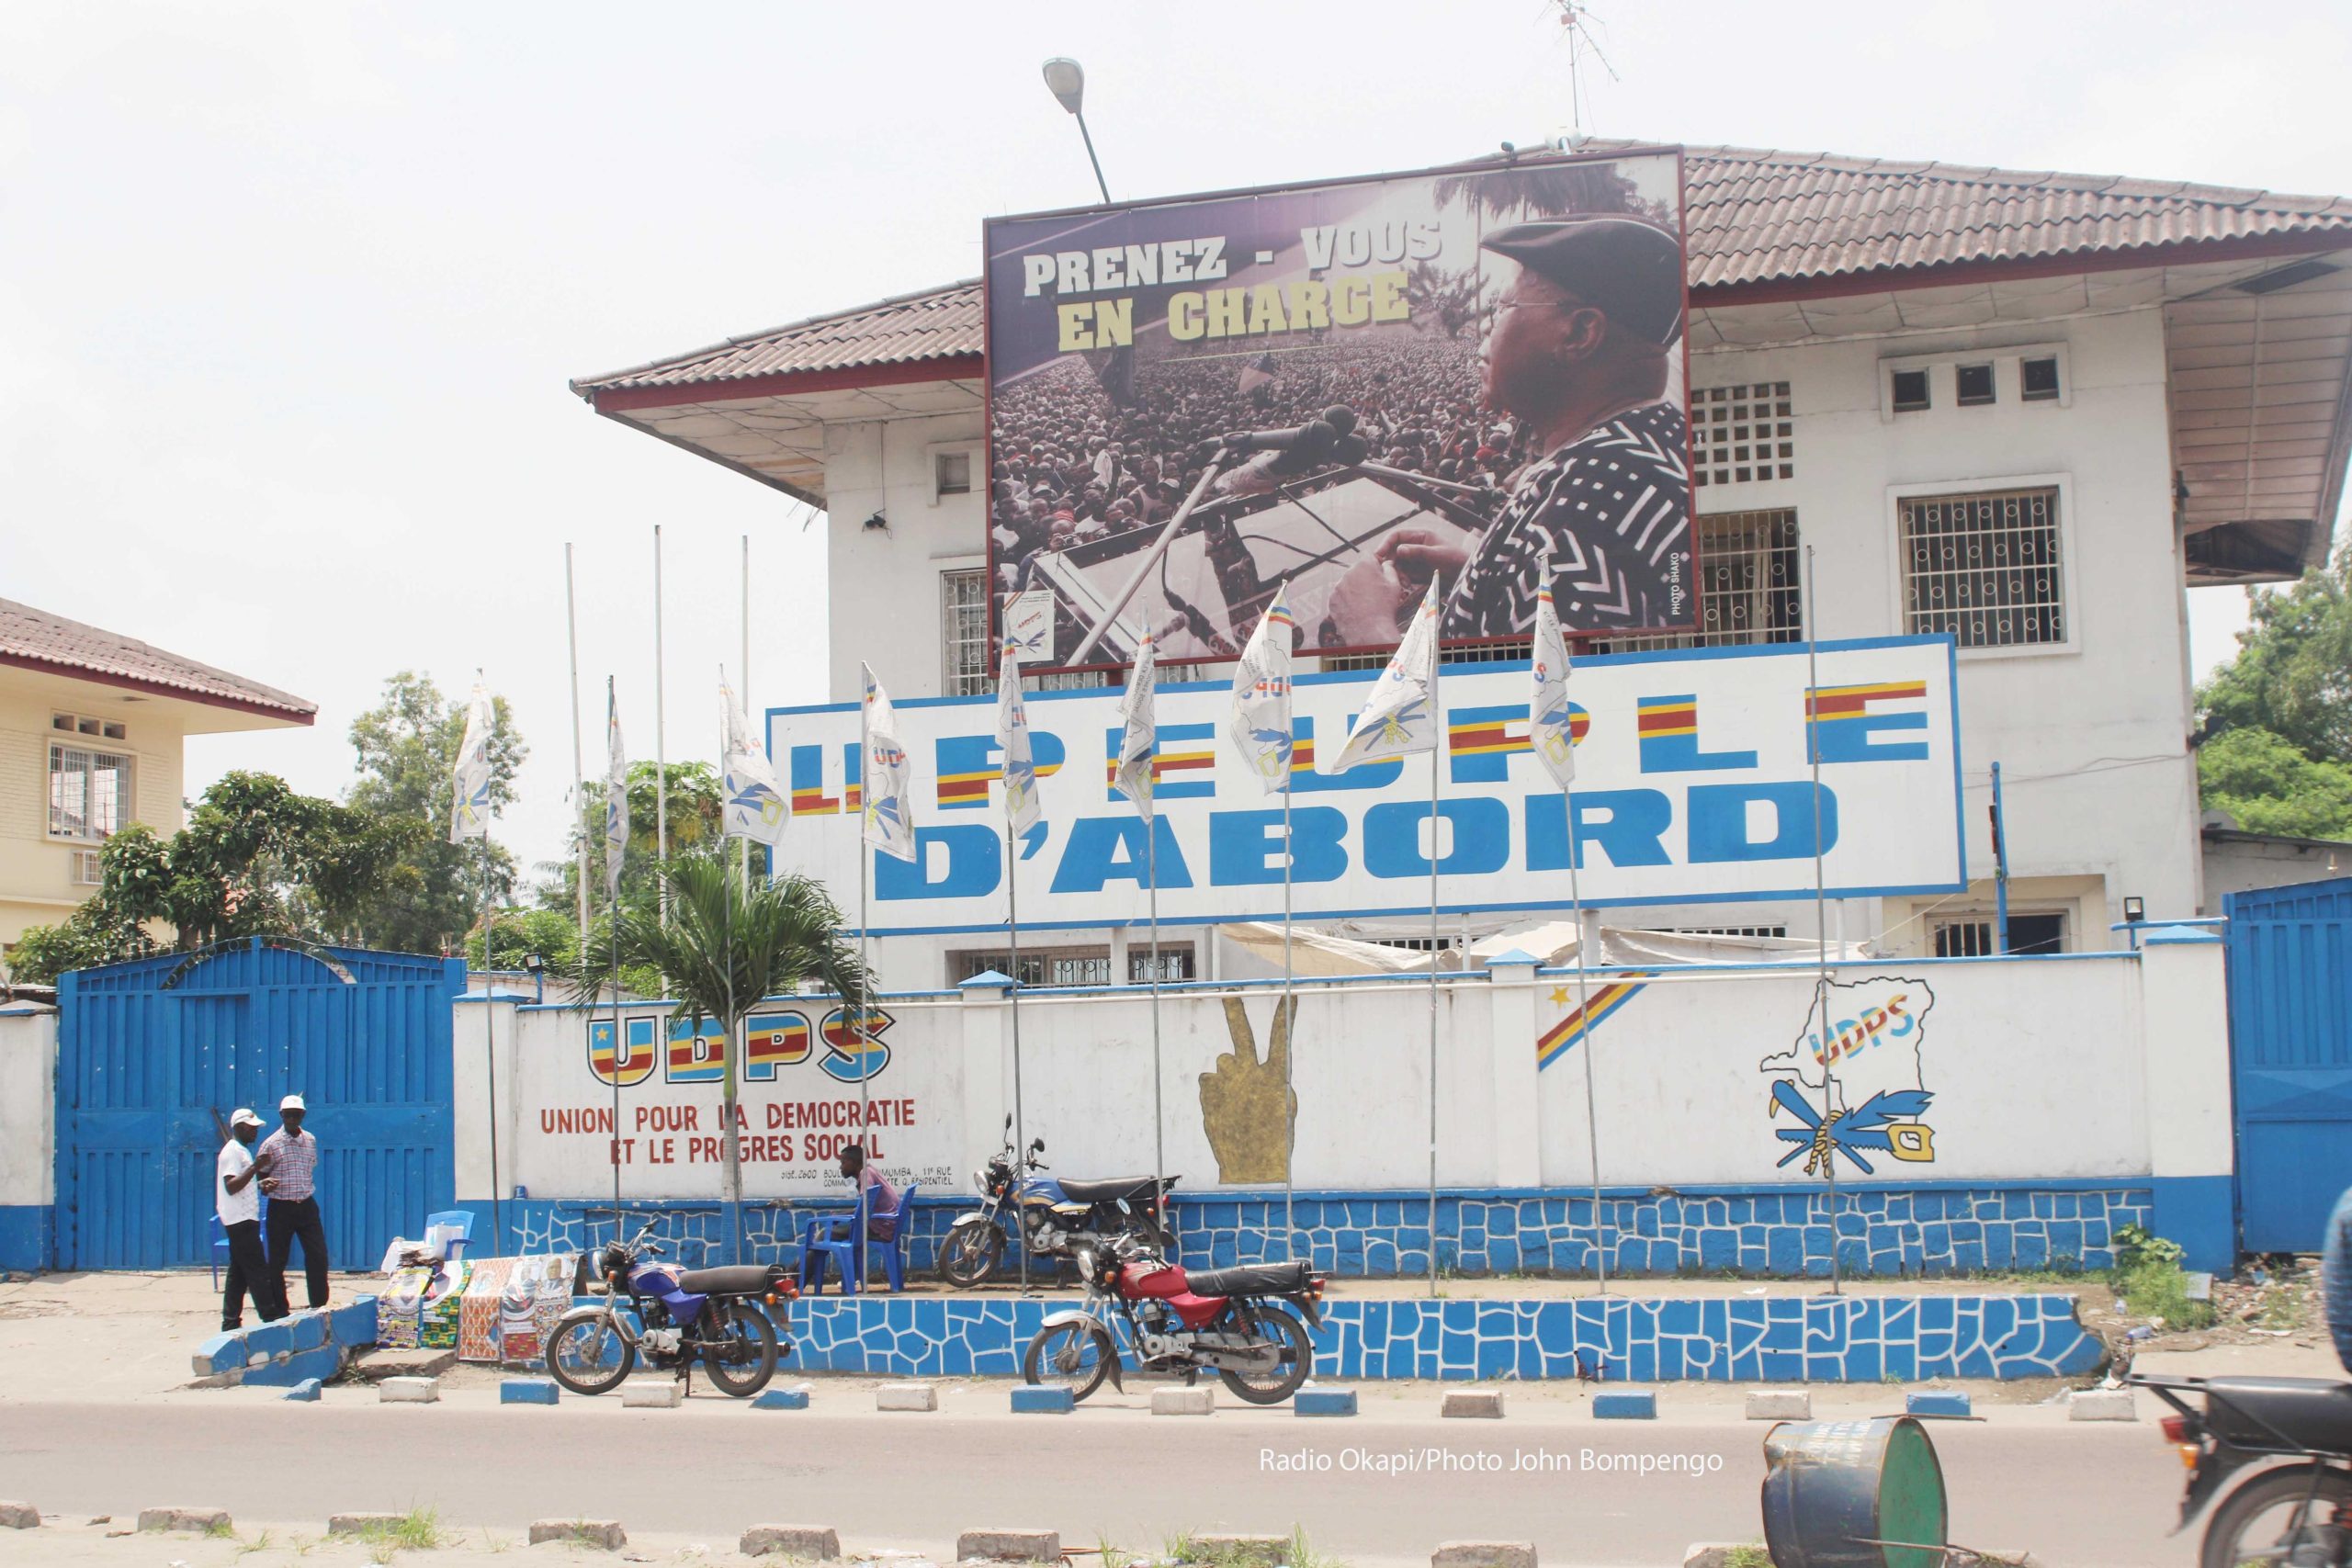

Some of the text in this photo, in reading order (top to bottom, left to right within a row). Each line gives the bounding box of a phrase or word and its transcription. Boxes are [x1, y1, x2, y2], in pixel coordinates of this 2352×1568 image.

[1023, 236, 1227, 297] PRENEZ
[1301, 219, 1442, 270] VOUS
[1057, 271, 1409, 352] EN CHARGE
[1670, 552, 1680, 615] PHOTO SHAKO
[587, 1009, 896, 1088] UDPS
[1807, 993, 1915, 1067] UDPS
[540, 1107, 614, 1134] UNION
[635, 1105, 699, 1133] POUR
[765, 1099, 915, 1130] DEMOCRATIE
[610, 1138, 636, 1165] ET
[649, 1138, 674, 1164] LE
[688, 1134, 794, 1164] PRGRES
[936, 1166, 953, 1176] RUE
